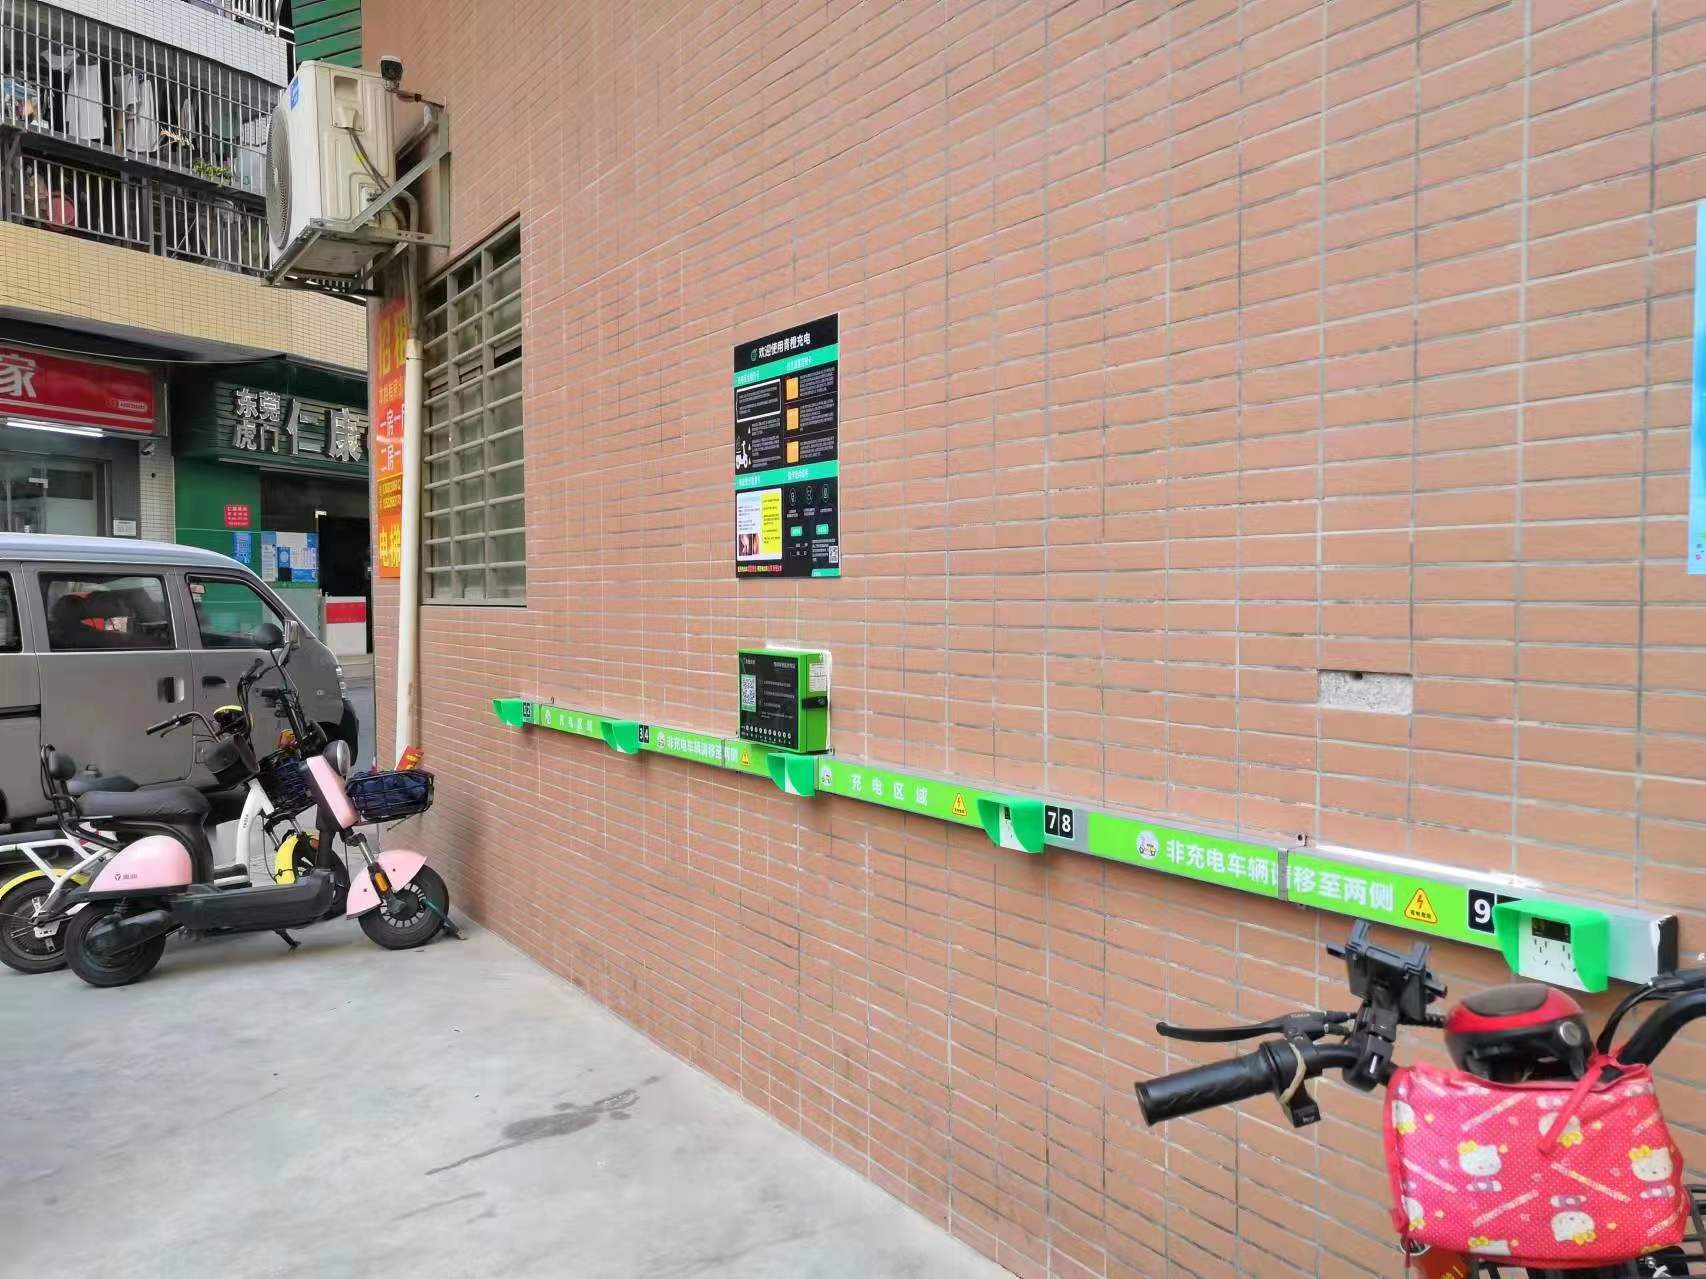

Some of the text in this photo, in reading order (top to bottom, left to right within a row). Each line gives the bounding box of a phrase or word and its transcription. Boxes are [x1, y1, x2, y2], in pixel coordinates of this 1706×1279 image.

[0, 353, 37, 398] 家
[236, 387, 281, 422] 东莞
[232, 419, 280, 453] 虎门
[286, 398, 363, 462] 仁康
[850, 774, 929, 806] 充电区域
[1473, 898, 1491, 924] 9
